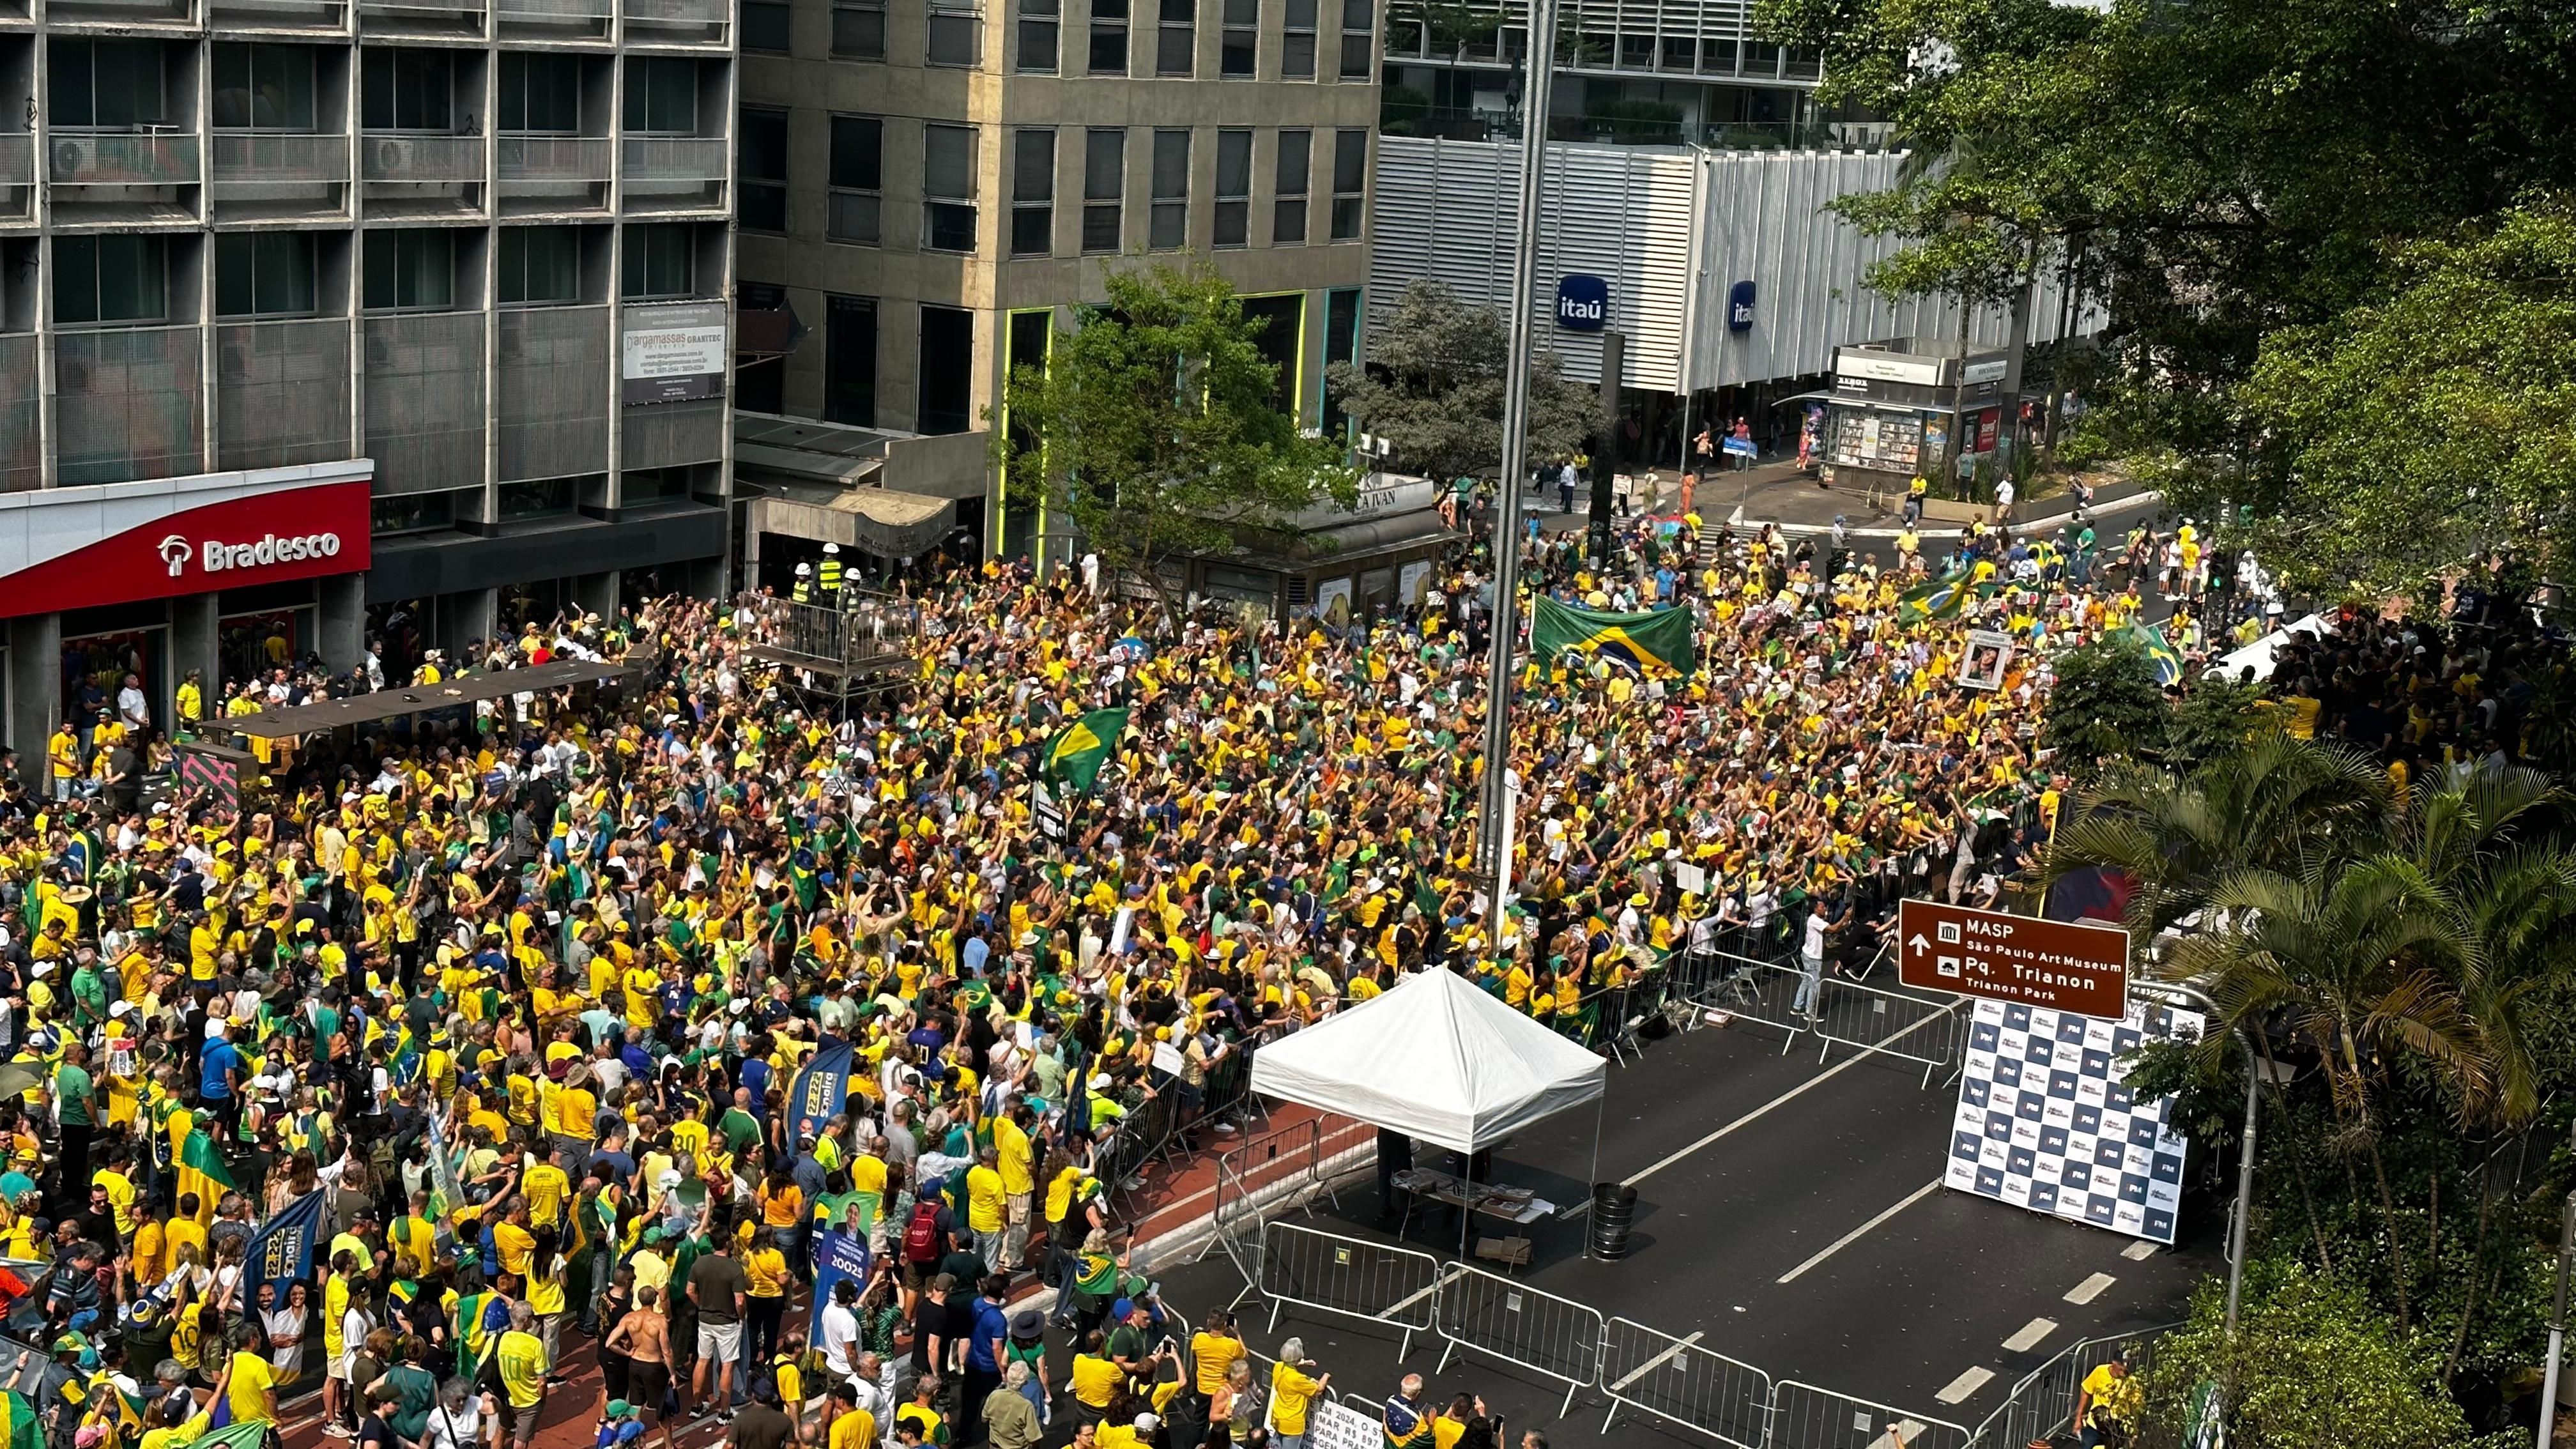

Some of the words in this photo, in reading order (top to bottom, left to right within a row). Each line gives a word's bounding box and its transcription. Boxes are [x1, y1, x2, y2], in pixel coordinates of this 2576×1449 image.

[1561, 296, 1601, 319] itaú
[1372, 490, 1396, 507] IVAN
[203, 532, 340, 572] Bradesco
[1966, 918, 2014, 939] MASP
[1966, 940, 1991, 952] São
[1996, 945, 2035, 959] Paulo
[2039, 952, 2060, 964] Art
[2064, 956, 2121, 972] Museum
[1966, 956, 1995, 976] Pq.
[2012, 964, 2095, 990] Trianon
[1966, 977, 2018, 994] Trianon
[2025, 987, 2055, 1000] Park
[831, 1254, 863, 1279] 20025
[174, 1326, 199, 1350] 10
[1315, 1425, 1338, 1443] PARA
[1345, 1427, 1356, 1439] R$
[1361, 1422, 1368, 1431] O
